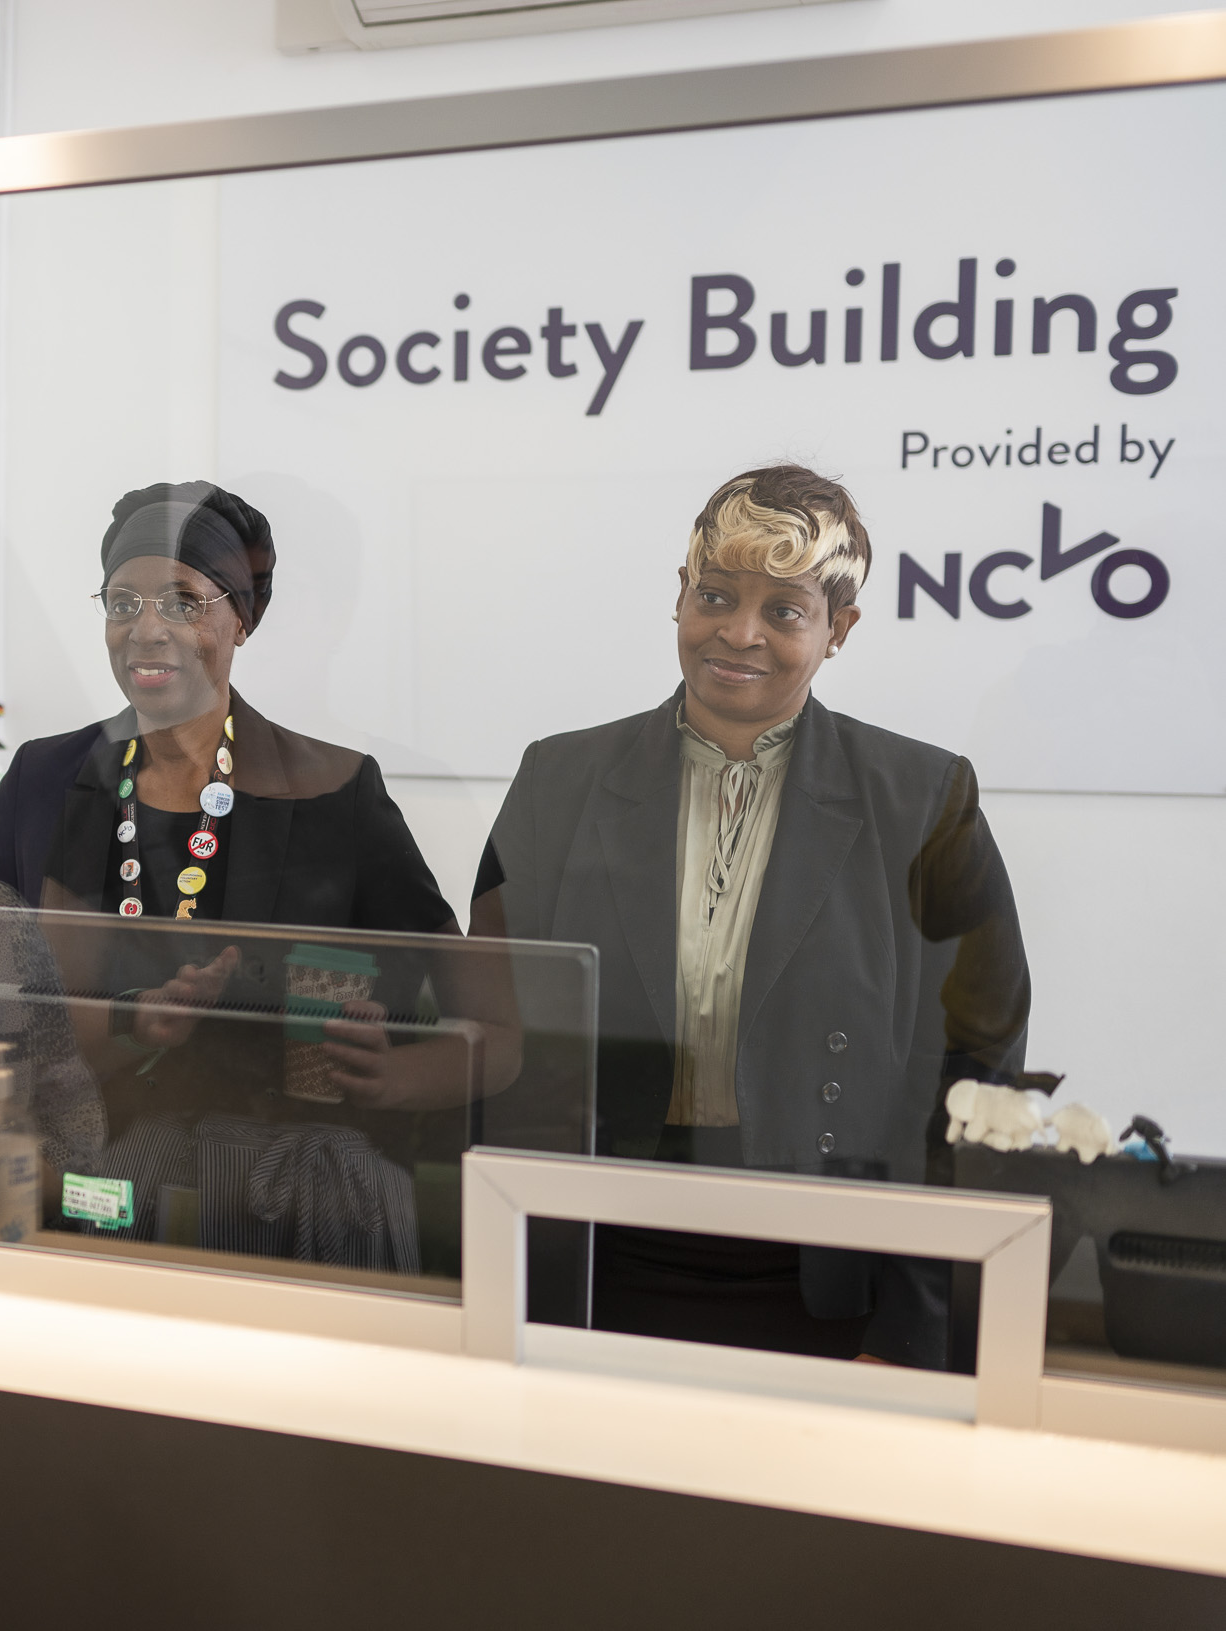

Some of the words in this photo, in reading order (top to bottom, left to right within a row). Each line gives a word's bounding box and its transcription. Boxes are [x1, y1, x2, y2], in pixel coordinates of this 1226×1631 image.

[273, 292, 646, 418] Society
[689, 256, 1180, 397] Building
[901, 423, 1101, 470] Provided
[1119, 421, 1176, 479] by
[897, 501, 1171, 620] NCVO
[192, 836, 214, 853] FUR
